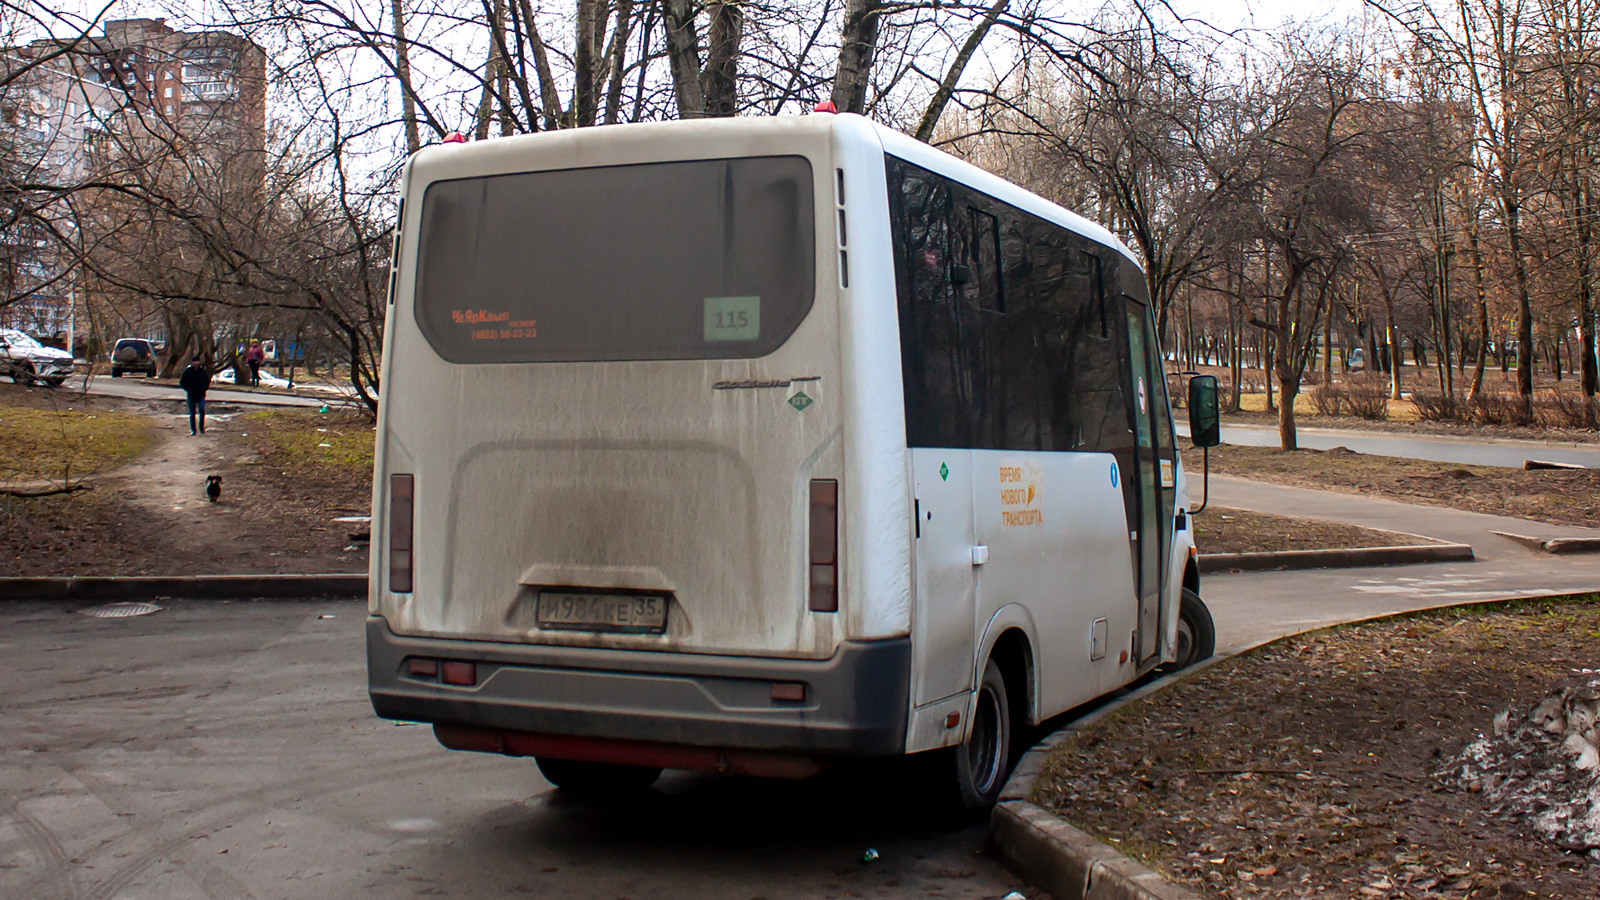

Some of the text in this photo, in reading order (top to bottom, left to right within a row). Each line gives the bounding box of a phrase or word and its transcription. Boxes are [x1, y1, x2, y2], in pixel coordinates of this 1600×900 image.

[715, 311, 749, 329] 115
[1000, 466, 1021, 483] ВРЕМЯ
[1000, 488, 1027, 505] НОВОГО
[1002, 509, 1043, 527] ТРАНСПОРТА
[635, 598, 656, 616] 35
